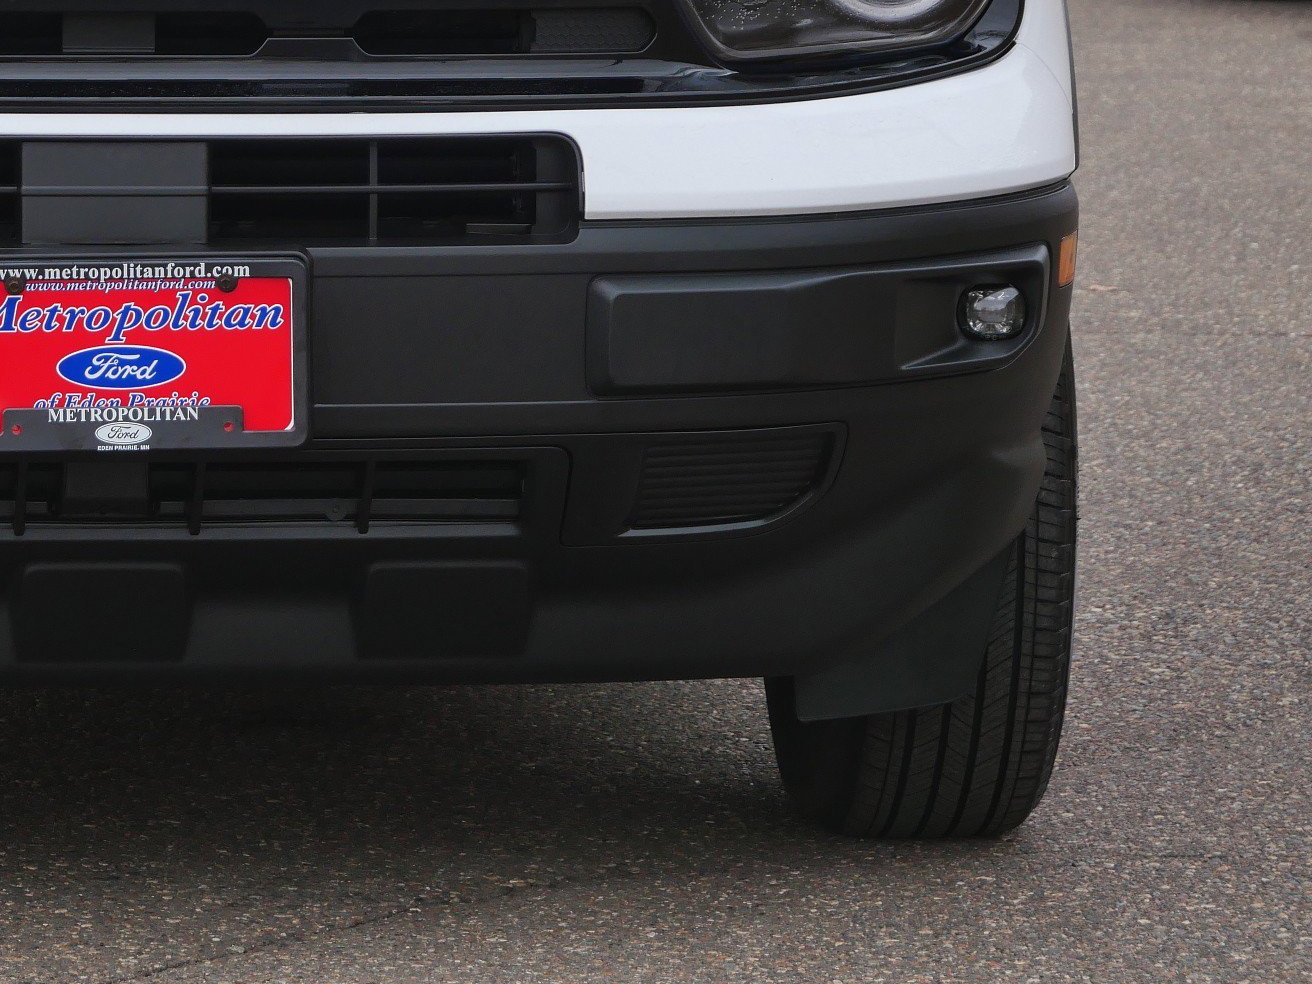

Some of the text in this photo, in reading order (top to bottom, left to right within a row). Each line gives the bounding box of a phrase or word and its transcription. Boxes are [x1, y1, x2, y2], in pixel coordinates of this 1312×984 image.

[25, 278, 217, 293] www.metropolitanford.com
[84, 352, 159, 380] Ford
[33, 391, 210, 408] of Eden Prairie
[48, 406, 199, 422] METROPOLITAN
[107, 425, 140, 439] Ford
